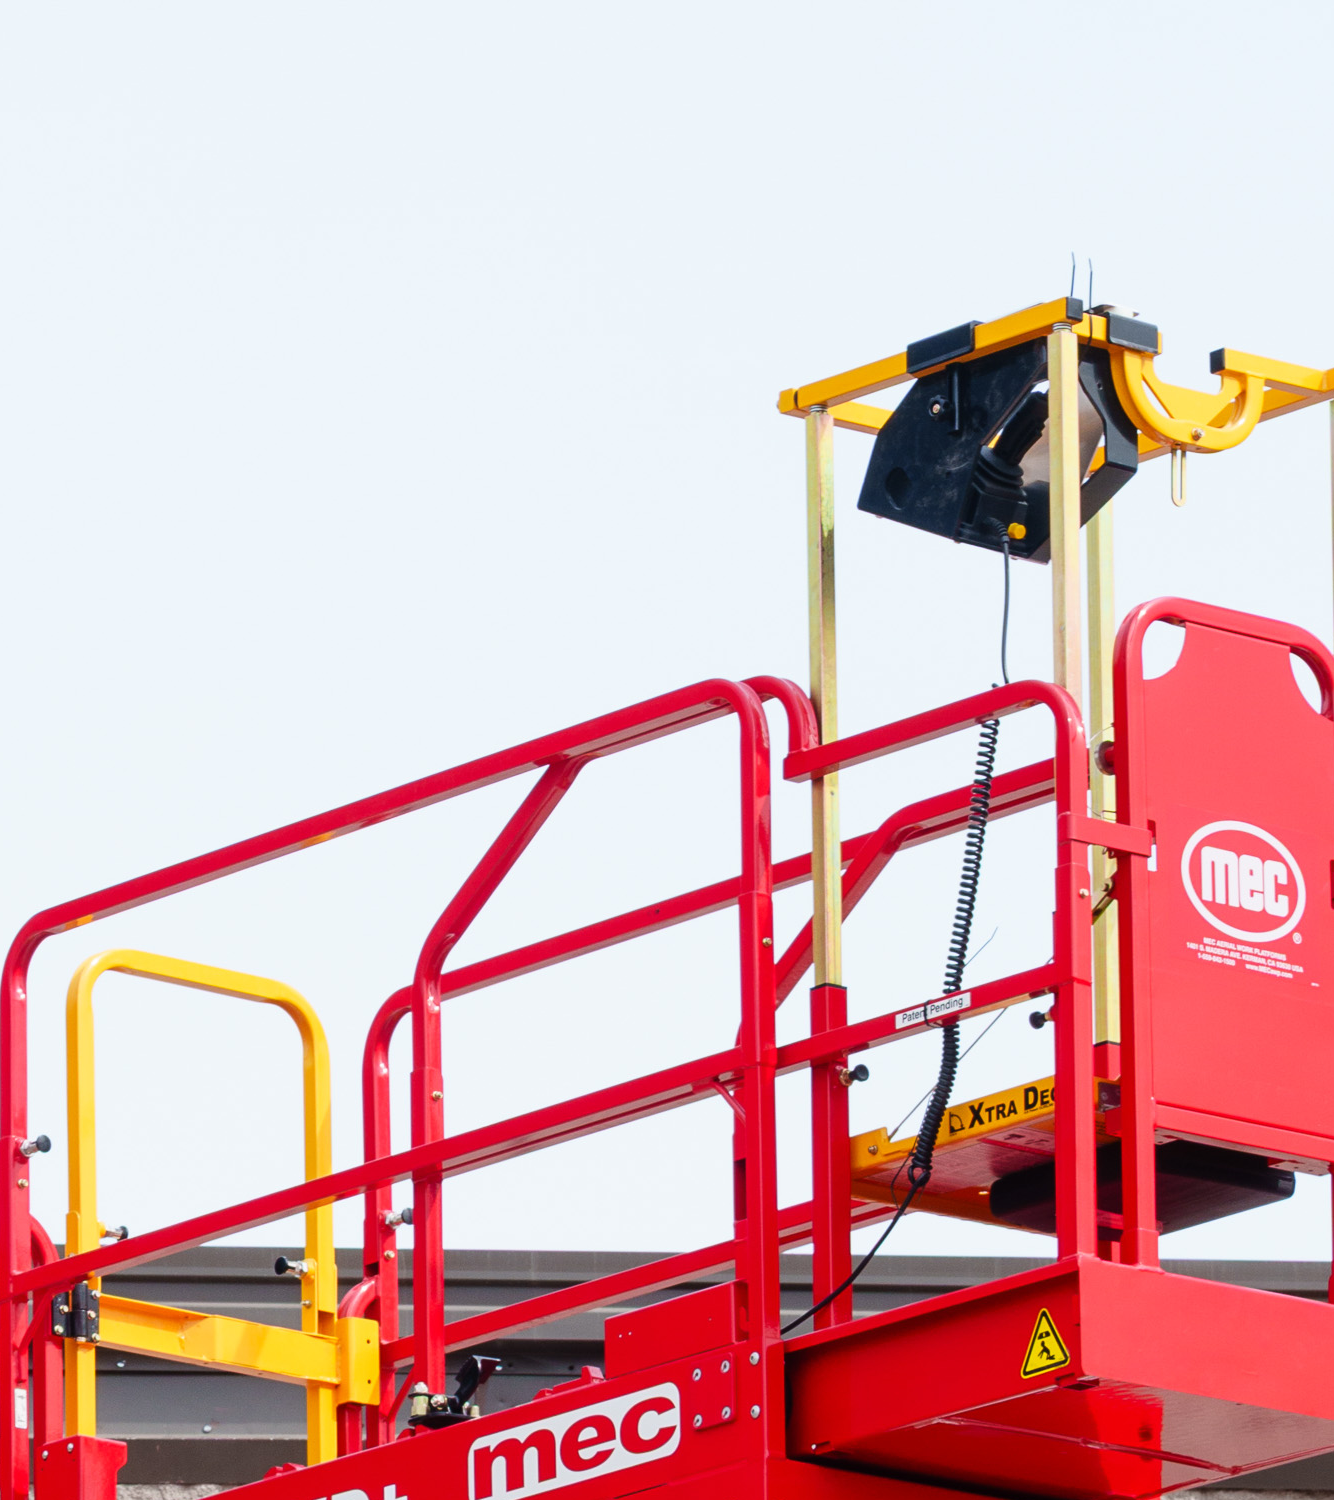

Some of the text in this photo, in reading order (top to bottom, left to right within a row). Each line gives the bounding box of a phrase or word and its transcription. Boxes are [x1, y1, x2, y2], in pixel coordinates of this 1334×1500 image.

[1201, 846, 1289, 918] mec
[902, 998, 963, 1023] Paten Pending
